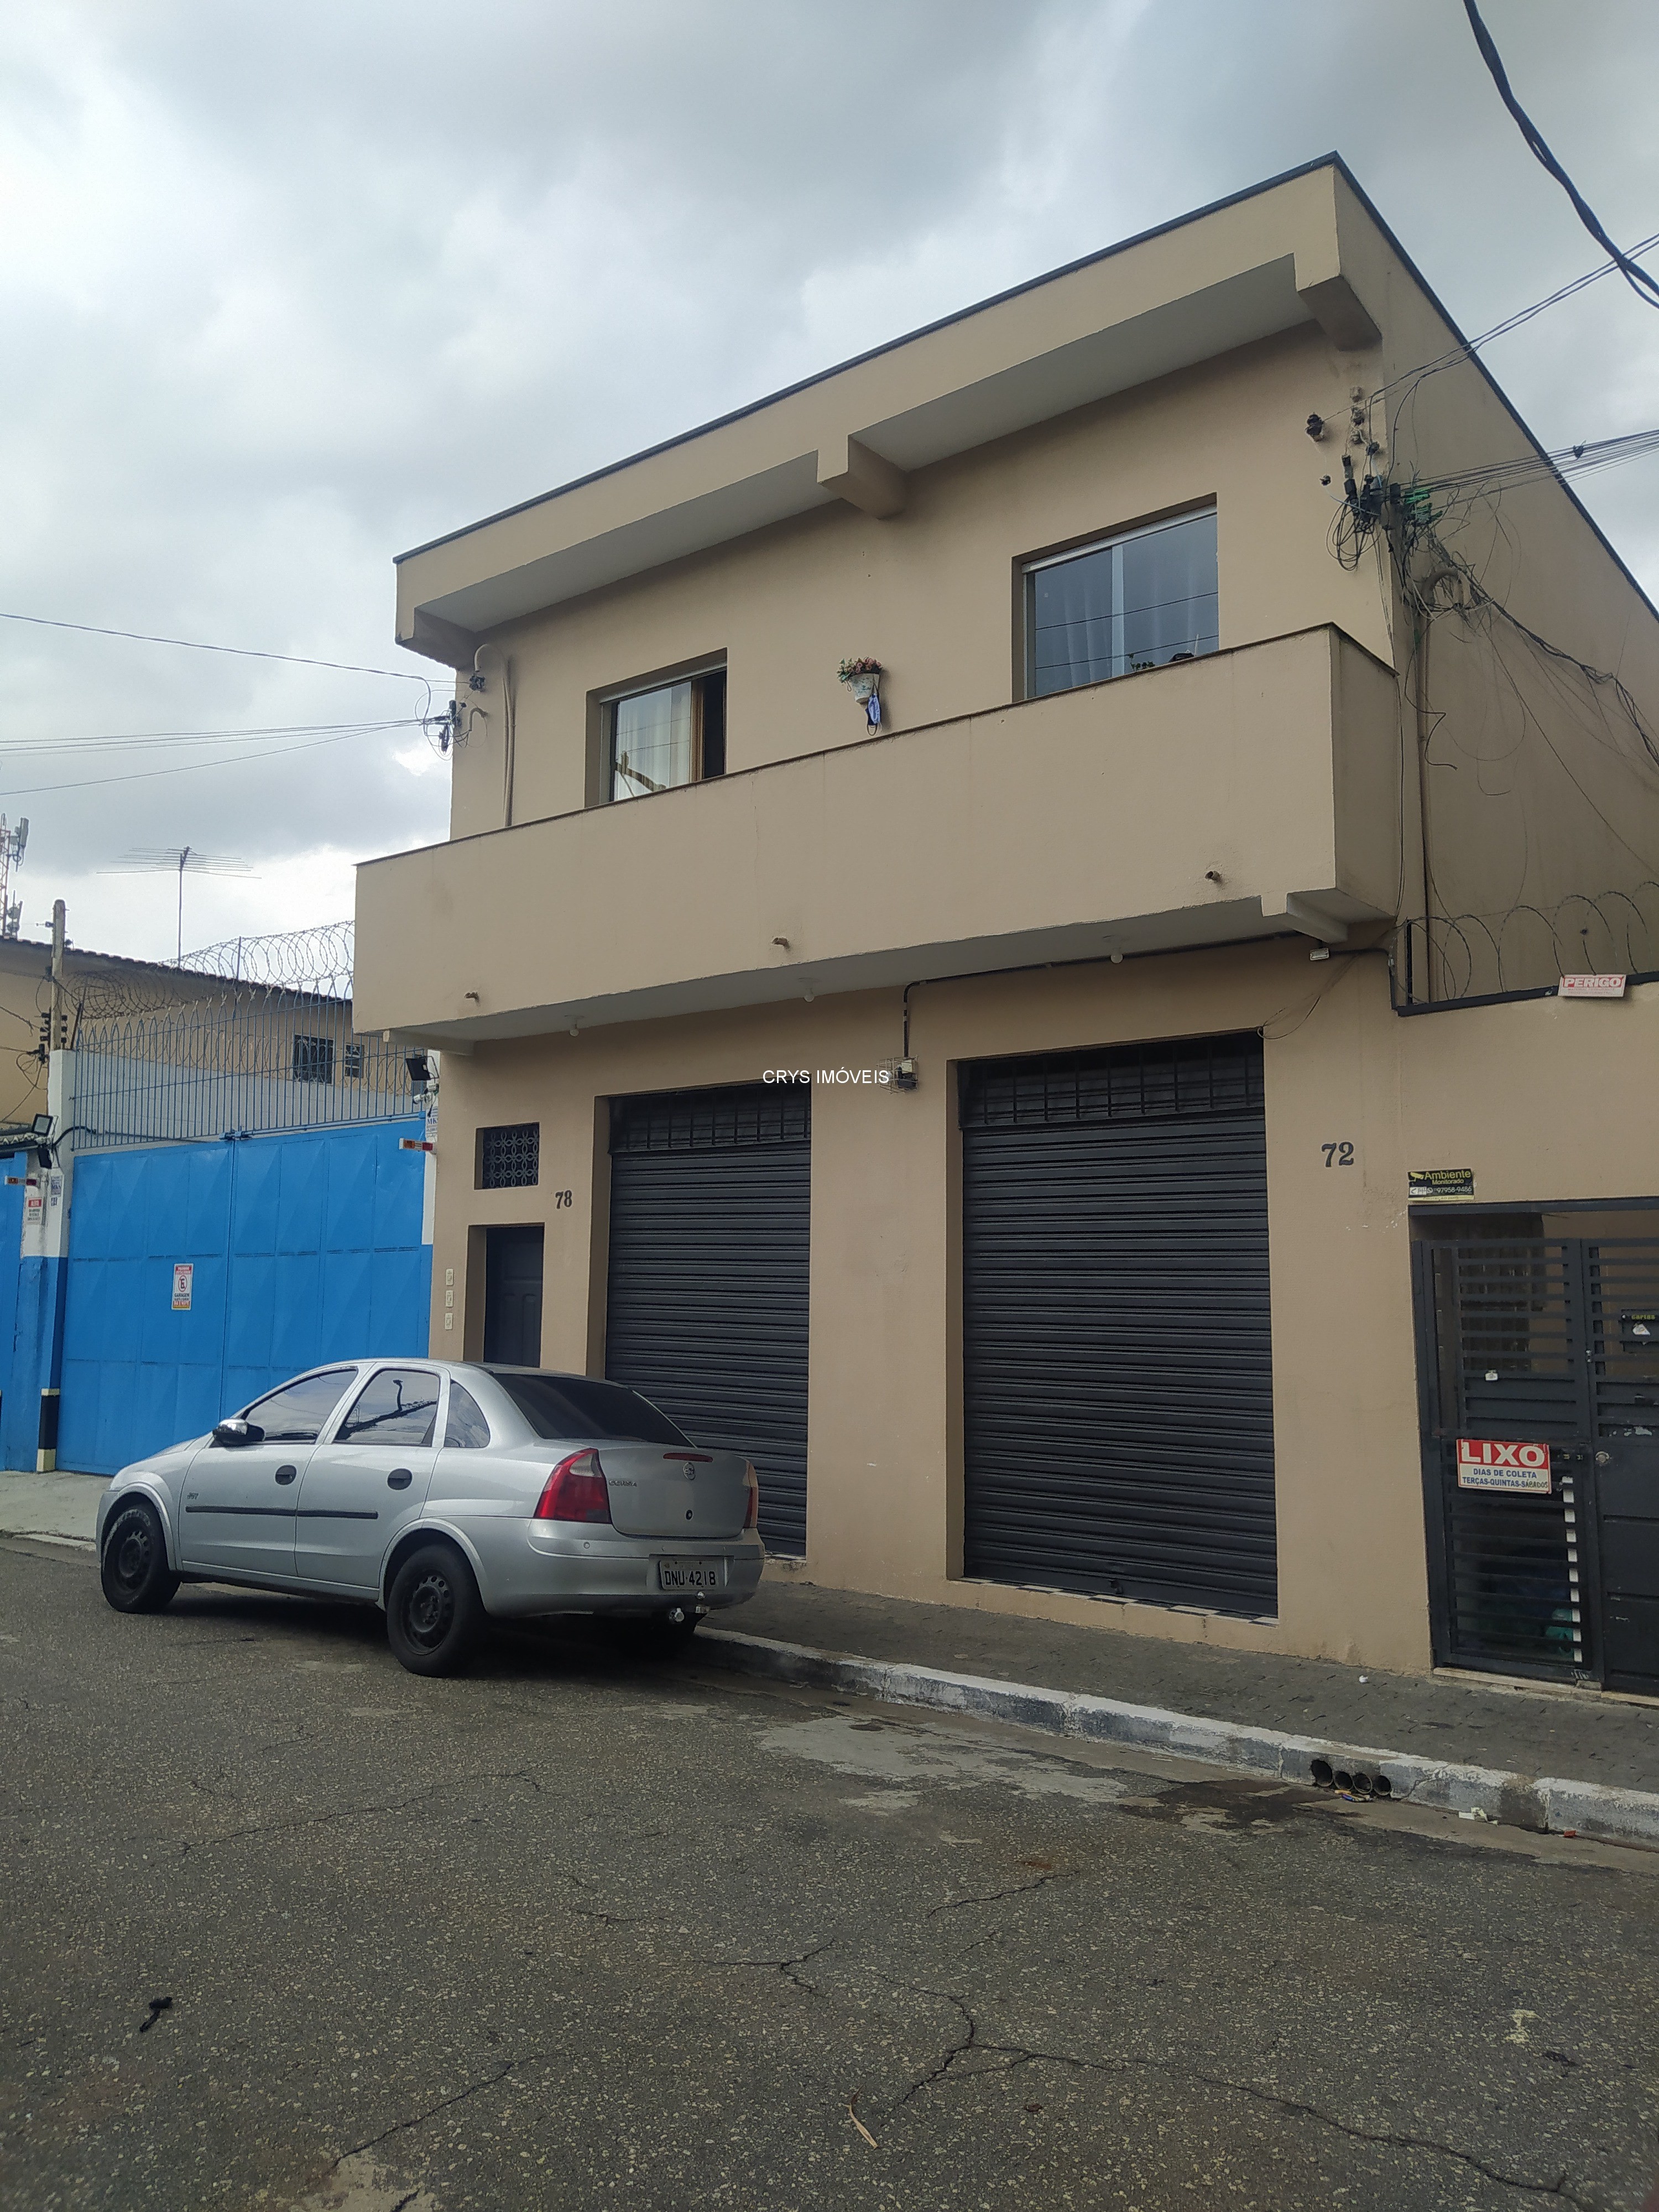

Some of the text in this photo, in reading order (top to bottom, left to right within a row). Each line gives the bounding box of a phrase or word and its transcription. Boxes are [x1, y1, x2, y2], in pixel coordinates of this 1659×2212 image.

[1563, 977, 1621, 987] PERIGO
[1321, 1141, 1354, 1167] 72
[1425, 1170, 1471, 1180] Ambiente
[555, 1190, 572, 1209] 78
[1462, 1441, 1545, 1467] LIXO
[1506, 1470, 1537, 1479] COLETA
